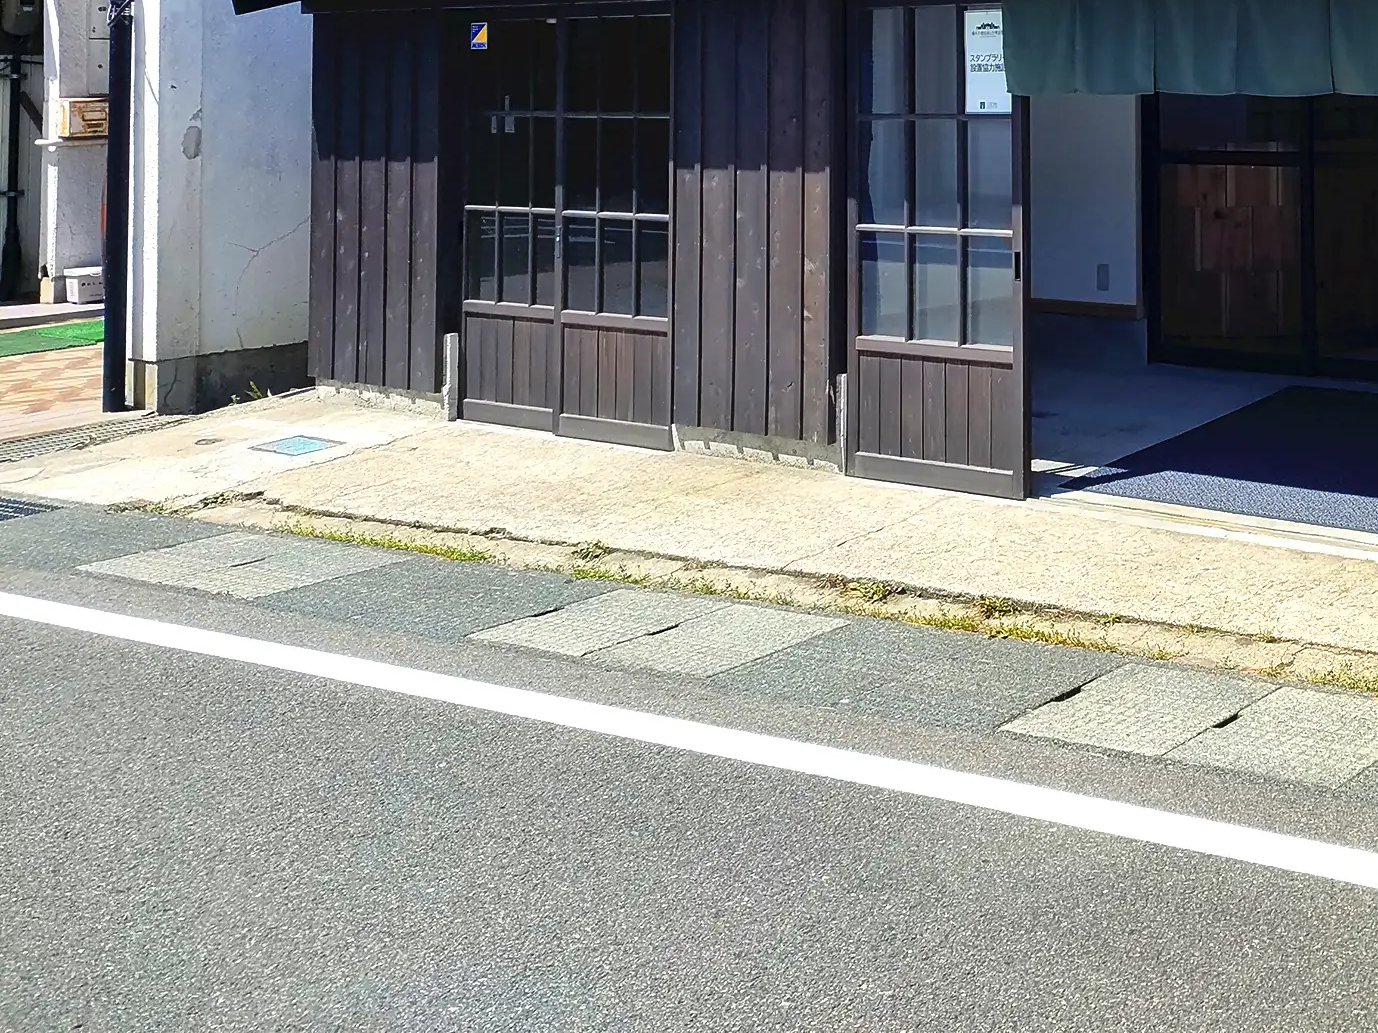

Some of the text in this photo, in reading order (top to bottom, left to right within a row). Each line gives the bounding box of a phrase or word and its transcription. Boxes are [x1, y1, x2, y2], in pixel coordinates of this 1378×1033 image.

[969, 53, 1004, 63] スタンプラリ
